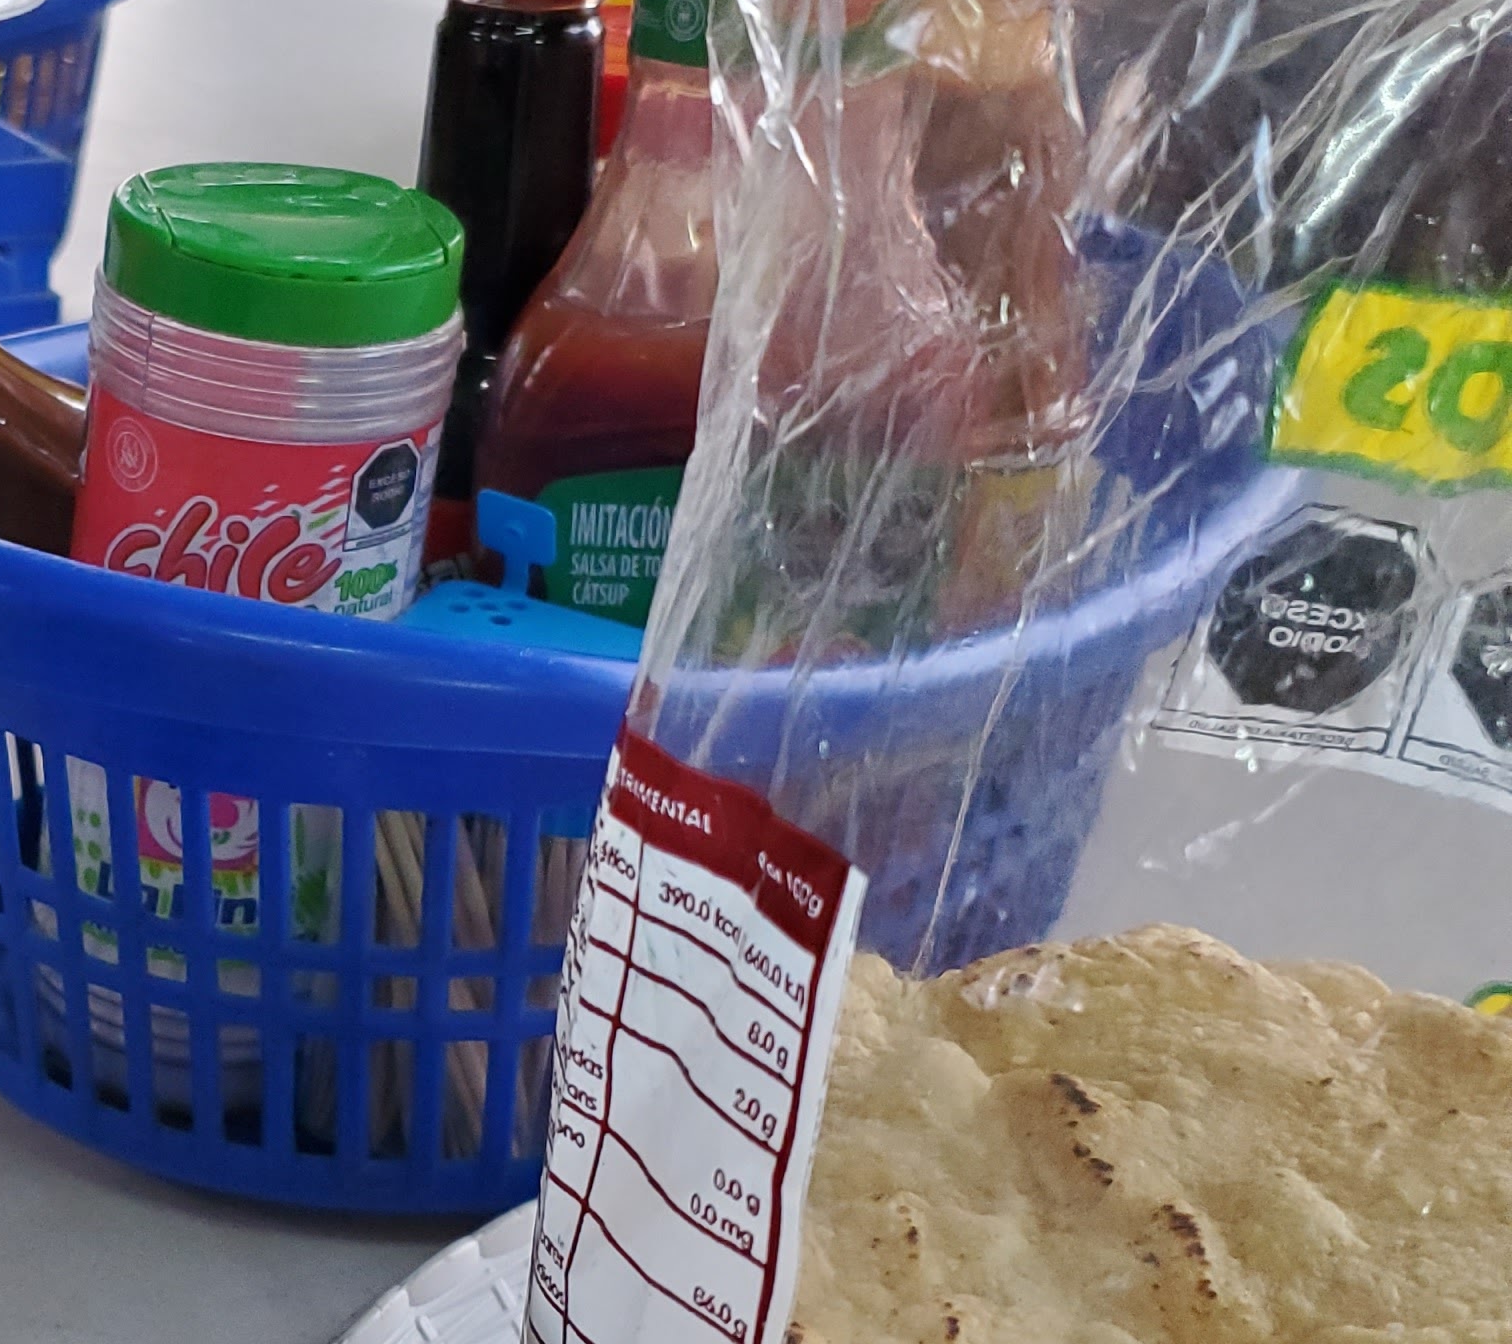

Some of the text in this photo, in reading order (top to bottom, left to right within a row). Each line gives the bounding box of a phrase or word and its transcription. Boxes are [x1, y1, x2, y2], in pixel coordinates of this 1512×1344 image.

[571, 552, 617, 577] SALSA
[619, 554, 639, 578] DE
[658, 880, 710, 922] 390.0
[747, 1020, 789, 1070] 8.0 g
[732, 1087, 778, 1139] 2.0 g
[713, 1167, 743, 1202] 0.0
[690, 1192, 718, 1226] 0.0
